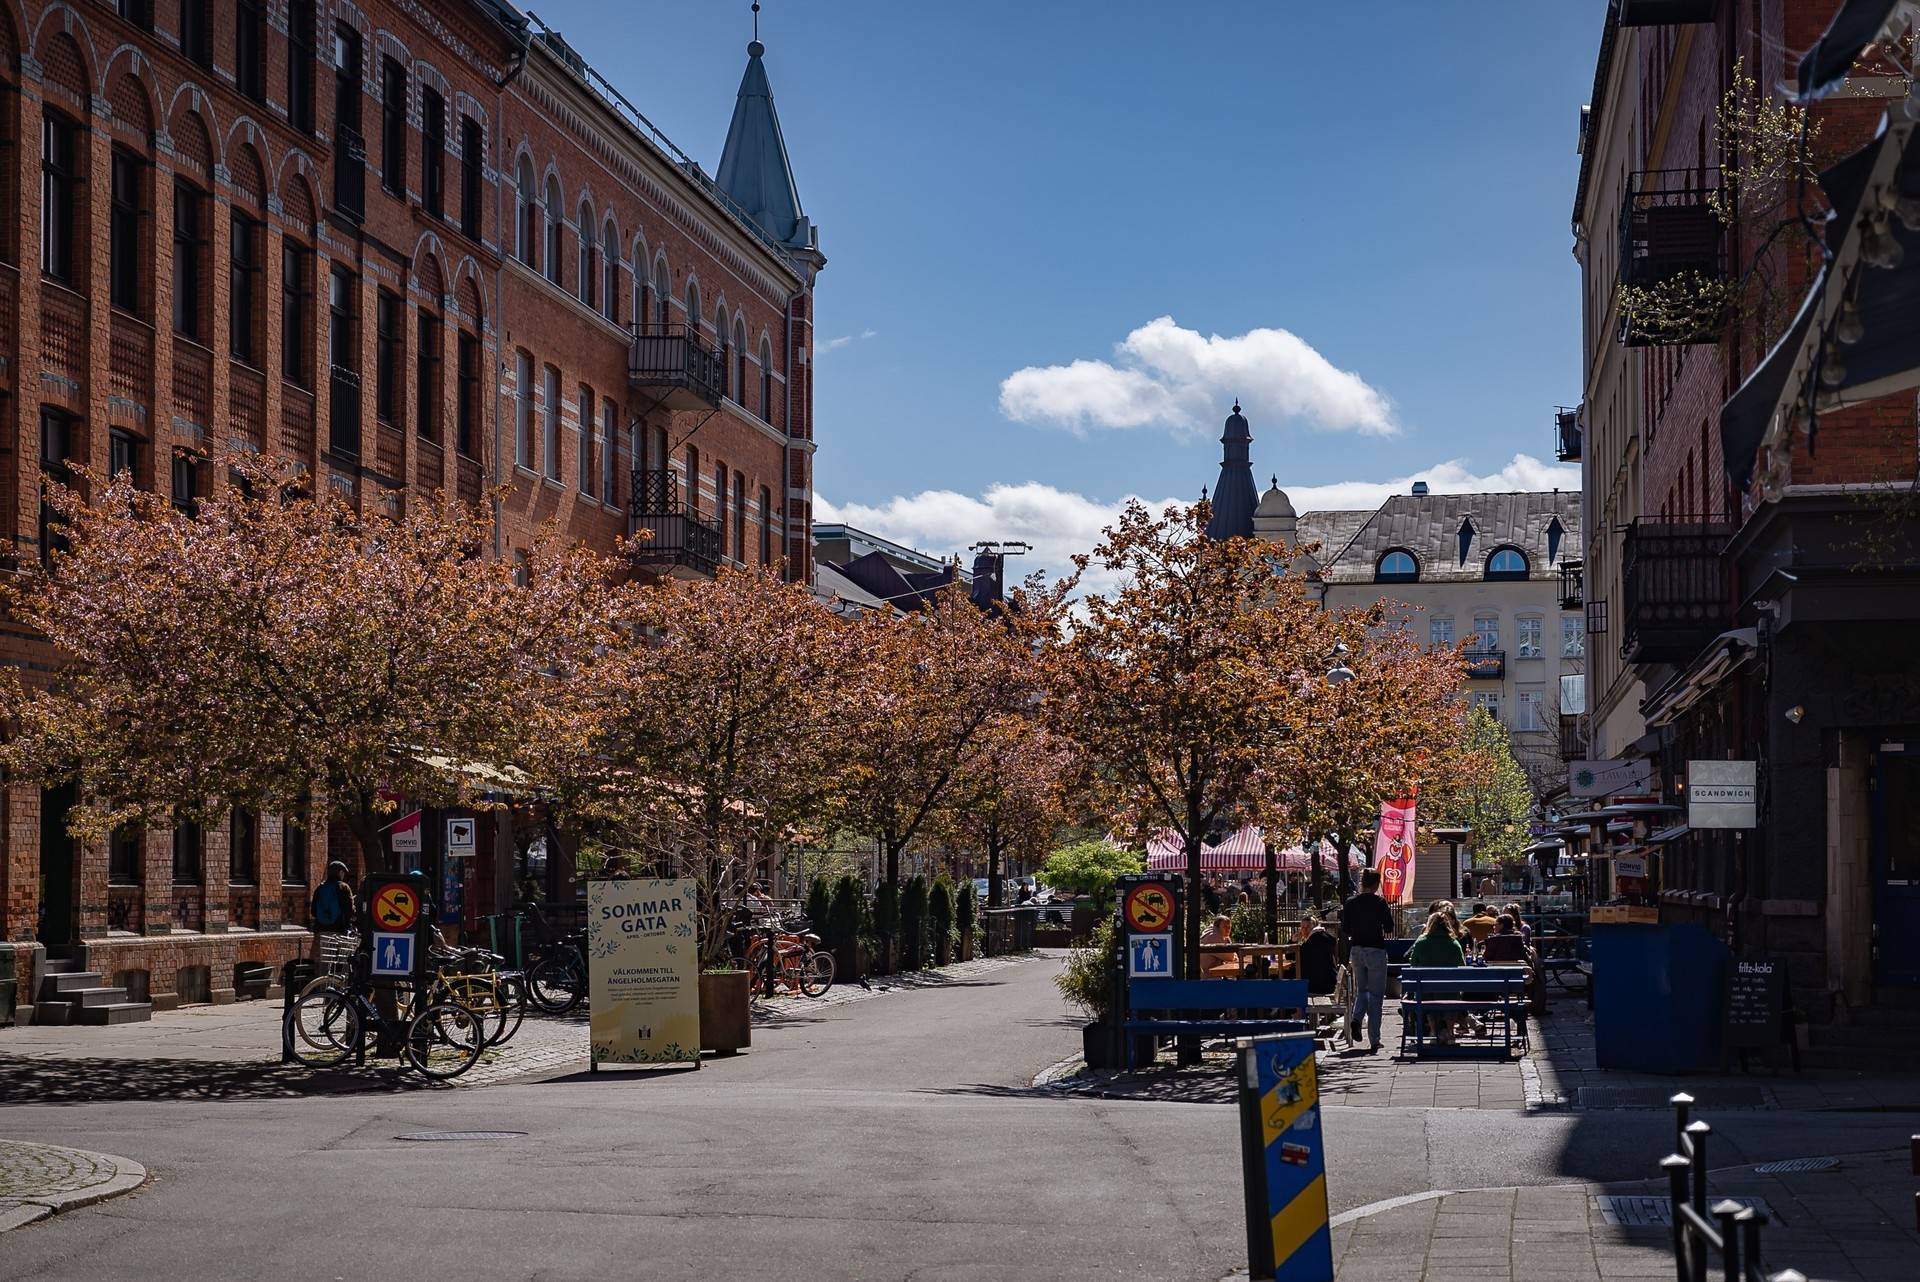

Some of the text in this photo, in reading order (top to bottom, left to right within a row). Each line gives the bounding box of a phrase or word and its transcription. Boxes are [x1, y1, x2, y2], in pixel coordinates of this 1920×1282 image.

[1695, 790, 1750, 798] SCANDWICH
[601, 898, 682, 920] SOMMAR
[621, 916, 667, 933] GATA
[613, 967, 659, 976] VÄLKOMMEN
